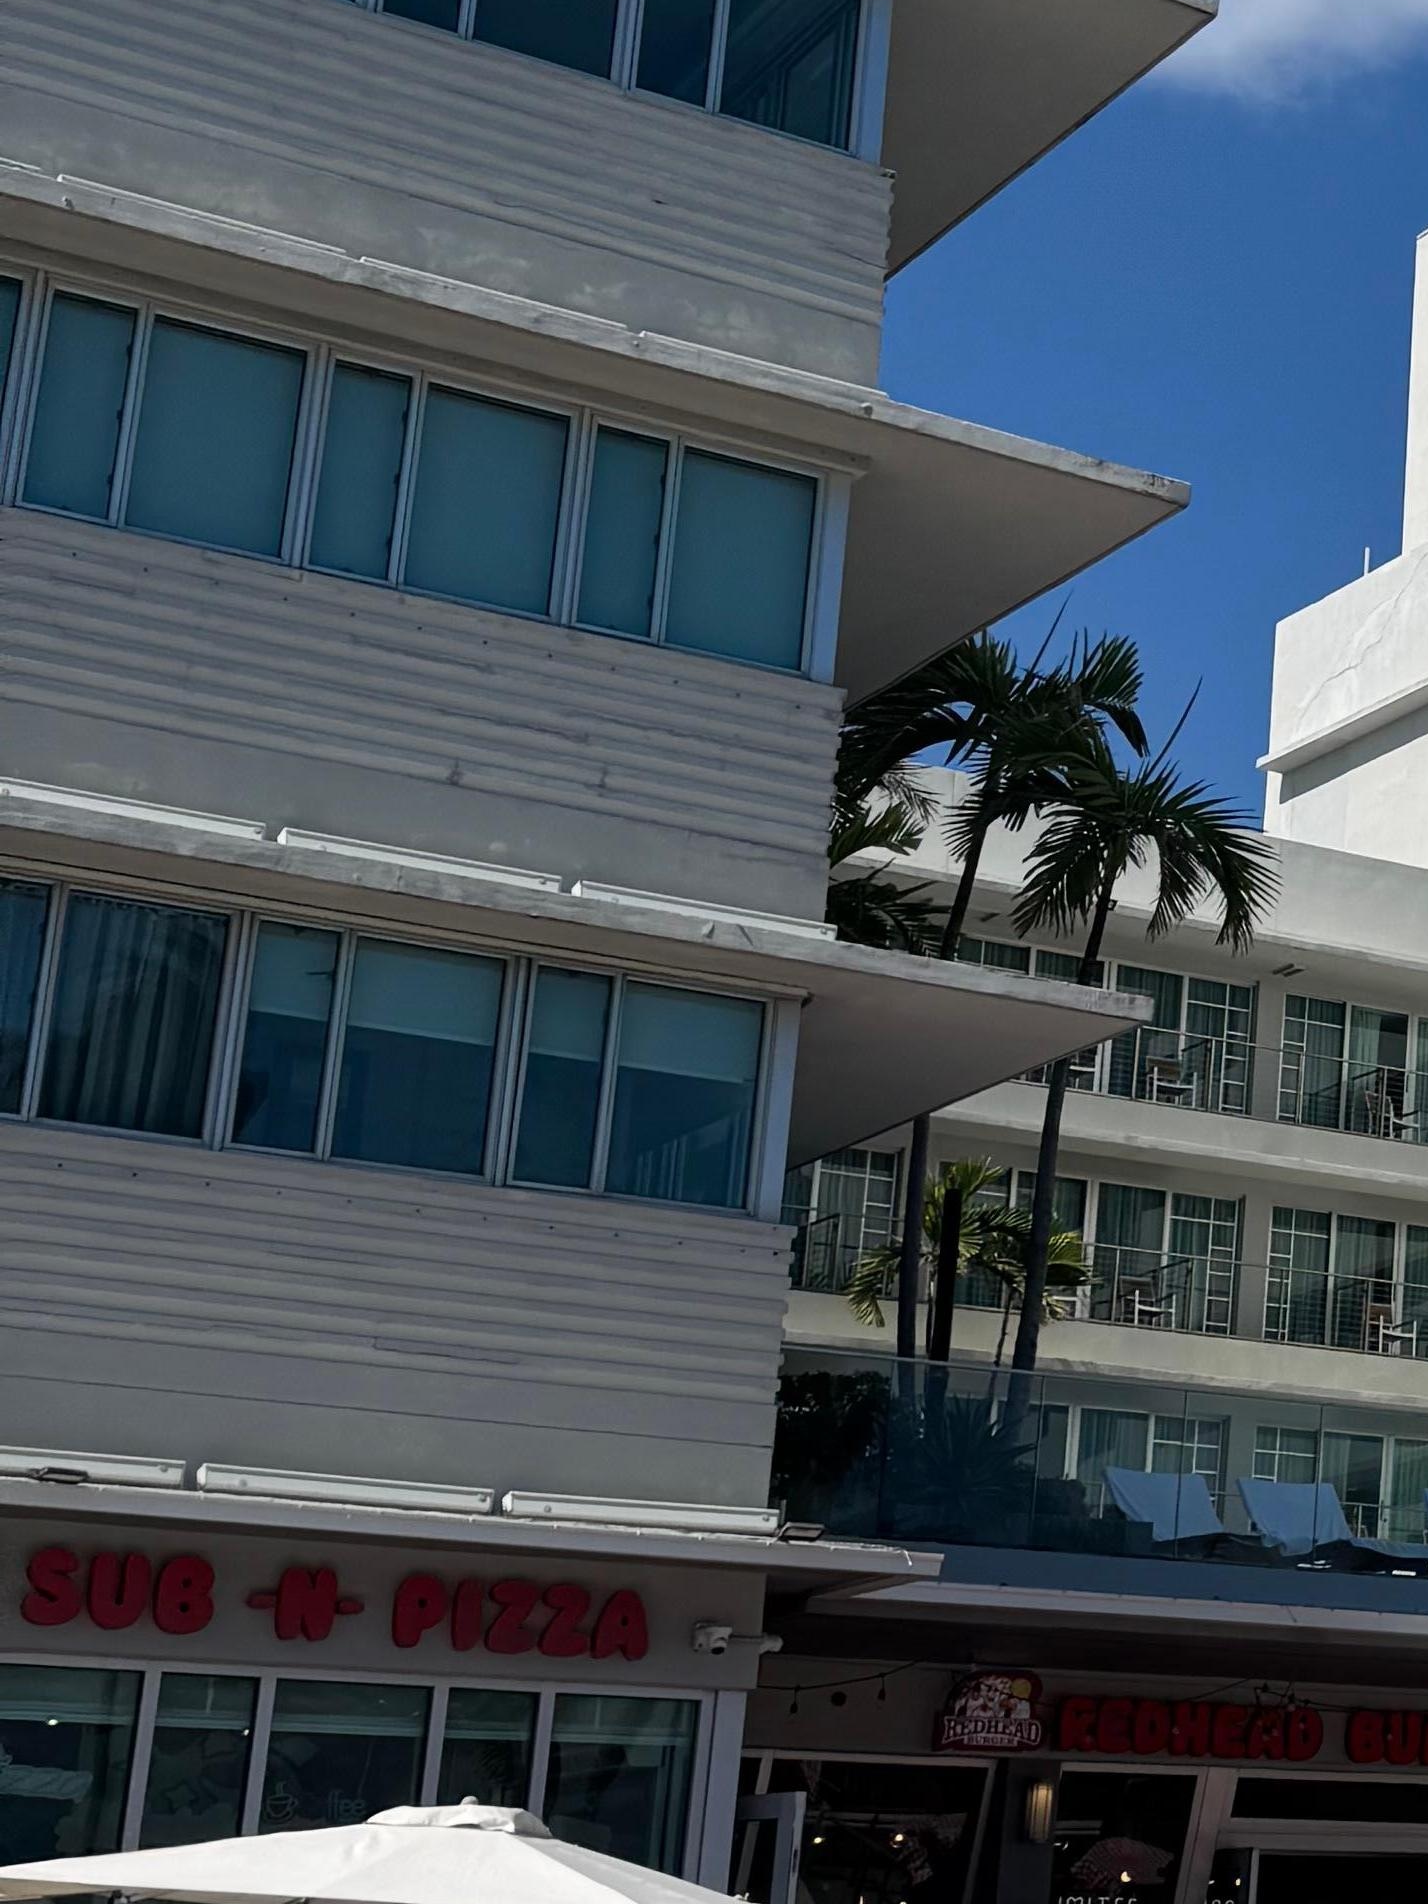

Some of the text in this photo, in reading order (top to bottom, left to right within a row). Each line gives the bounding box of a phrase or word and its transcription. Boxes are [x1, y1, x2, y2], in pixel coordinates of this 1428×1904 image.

[20, 1547, 216, 1635] SUB
[392, 1574, 650, 1662] PIZZA
[942, 1716, 1042, 1746] REDHEAD
[1055, 1696, 1322, 1763] REDHEAD
